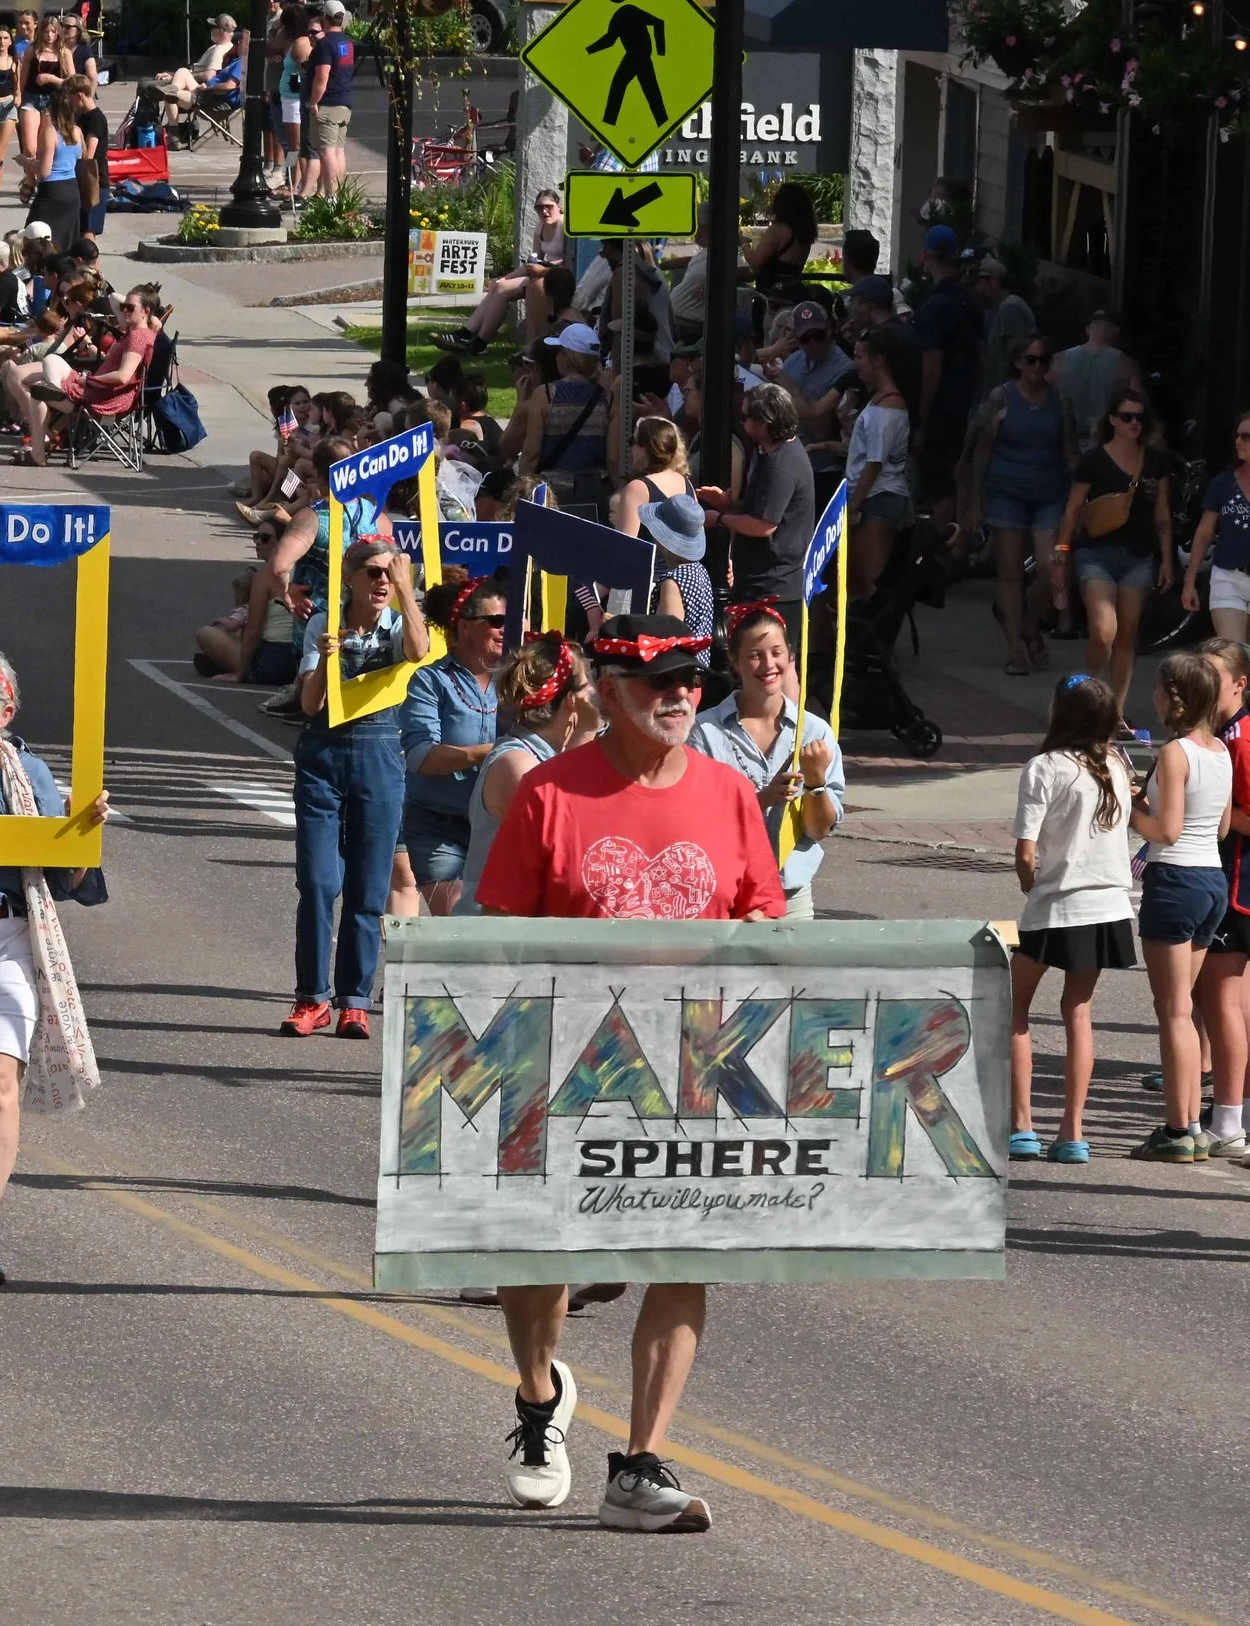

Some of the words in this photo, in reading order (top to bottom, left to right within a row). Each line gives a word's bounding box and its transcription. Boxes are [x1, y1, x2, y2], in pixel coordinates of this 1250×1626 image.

[440, 259, 478, 275] FEST
[441, 245, 479, 260] ARTS
[457, 282, 474, 290] 10-11
[333, 465, 357, 492] We
[358, 455, 388, 480] Can
[389, 444, 409, 468] Do
[412, 430, 428, 458] It!
[7, 513, 50, 544] Do
[64, 513, 96, 544] It!
[397, 530, 422, 550] W
[444, 530, 489, 552] Can
[497, 532, 513, 553] D
[813, 545, 825, 578] Can
[825, 526, 837, 554] Do
[396, 982, 1002, 1182] MAKER
[577, 1139, 833, 1178] SPHERE
[578, 1184, 658, 1214] What
[654, 1187, 700, 1210] will
[698, 1190, 746, 1217] you
[746, 1182, 826, 1211] make?
